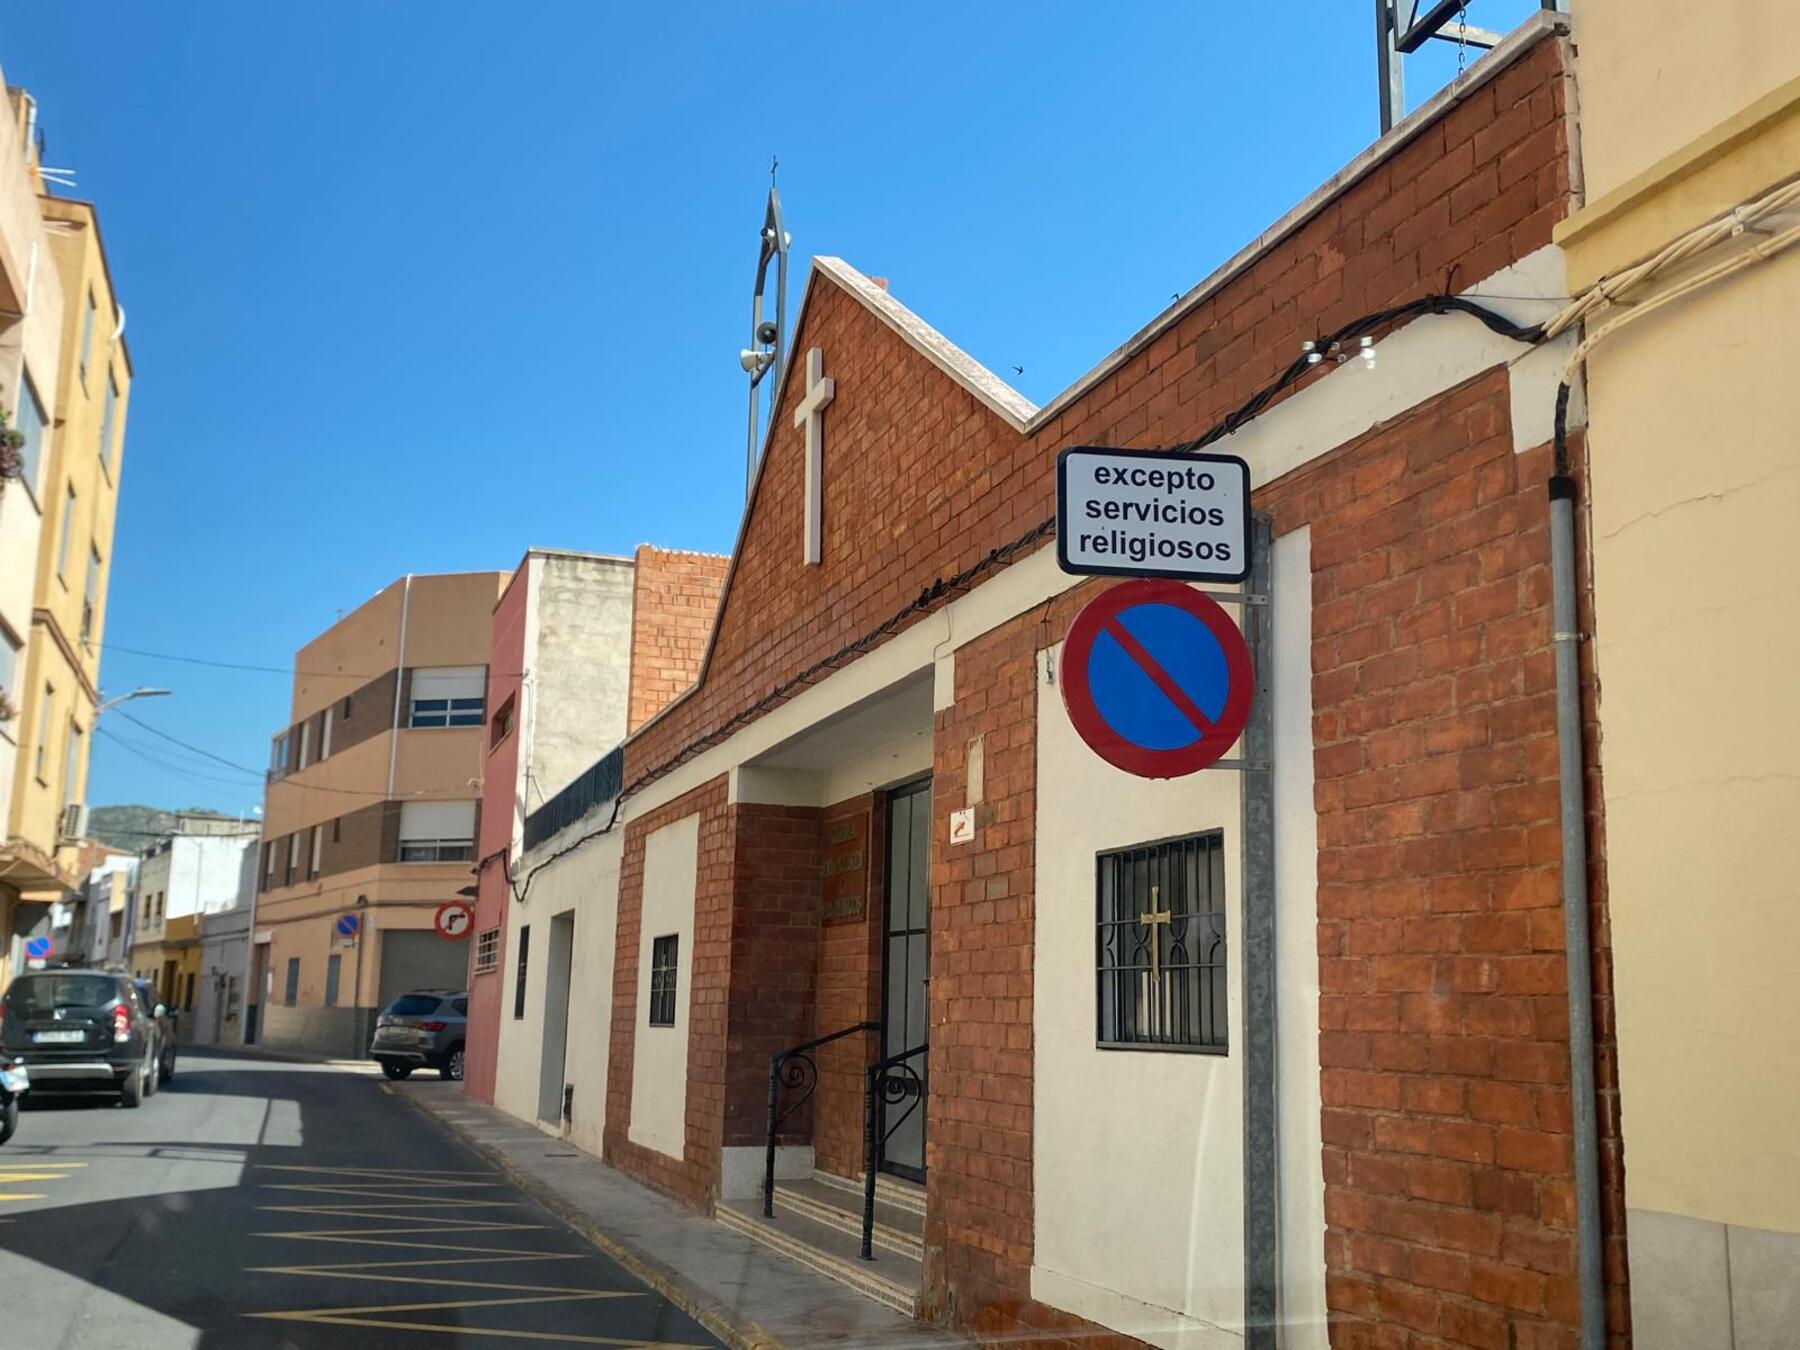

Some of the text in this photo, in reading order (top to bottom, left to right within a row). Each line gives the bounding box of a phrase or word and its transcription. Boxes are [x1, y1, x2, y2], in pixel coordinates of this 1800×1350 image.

[1094, 466, 1215, 494] excepto
[1085, 498, 1224, 526] servicios
[1080, 530, 1231, 562] religiosos
